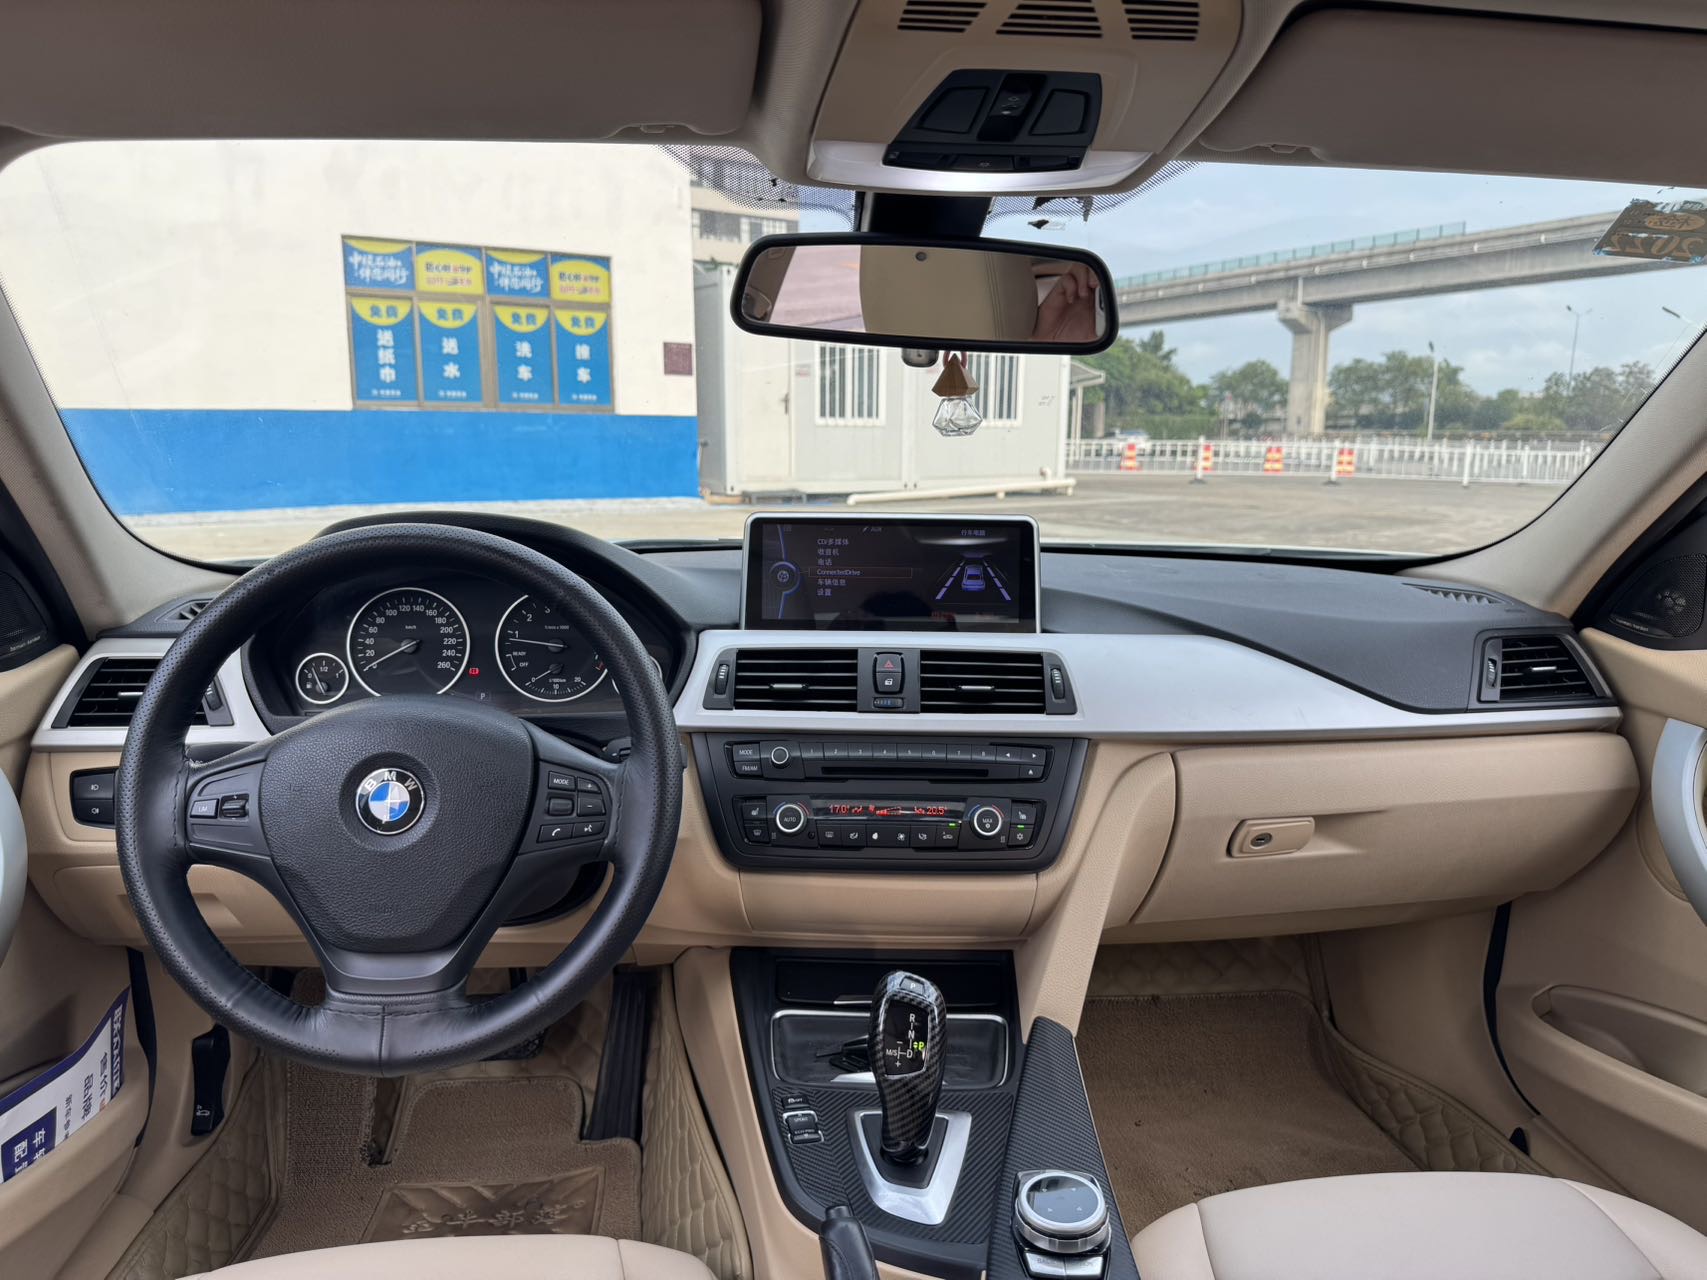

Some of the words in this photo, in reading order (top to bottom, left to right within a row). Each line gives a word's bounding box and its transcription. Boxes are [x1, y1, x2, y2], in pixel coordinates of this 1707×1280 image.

[370, 305, 398, 319] 免费
[437, 308, 464, 322] 免费
[511, 312, 537, 326] 免费
[571, 315, 596, 329] 免费
[442, 336, 461, 379] 送水
[514, 341, 533, 382] 洗车
[527, 613, 533, 622] 2
[368, 626, 378, 634] 60
[440, 626, 454, 634] 200
[442, 649, 456, 657] 240
[437, 661, 451, 669] 260
[364, 770, 418, 792] BMW
[553, 778, 569, 786] MODE
[909, 1013, 916, 1023] R
[908, 1029, 915, 1040] N
[885, 1048, 898, 1057] M/S
[906, 1048, 913, 1059] D
[81, 1072, 94, 1121] 品牌
